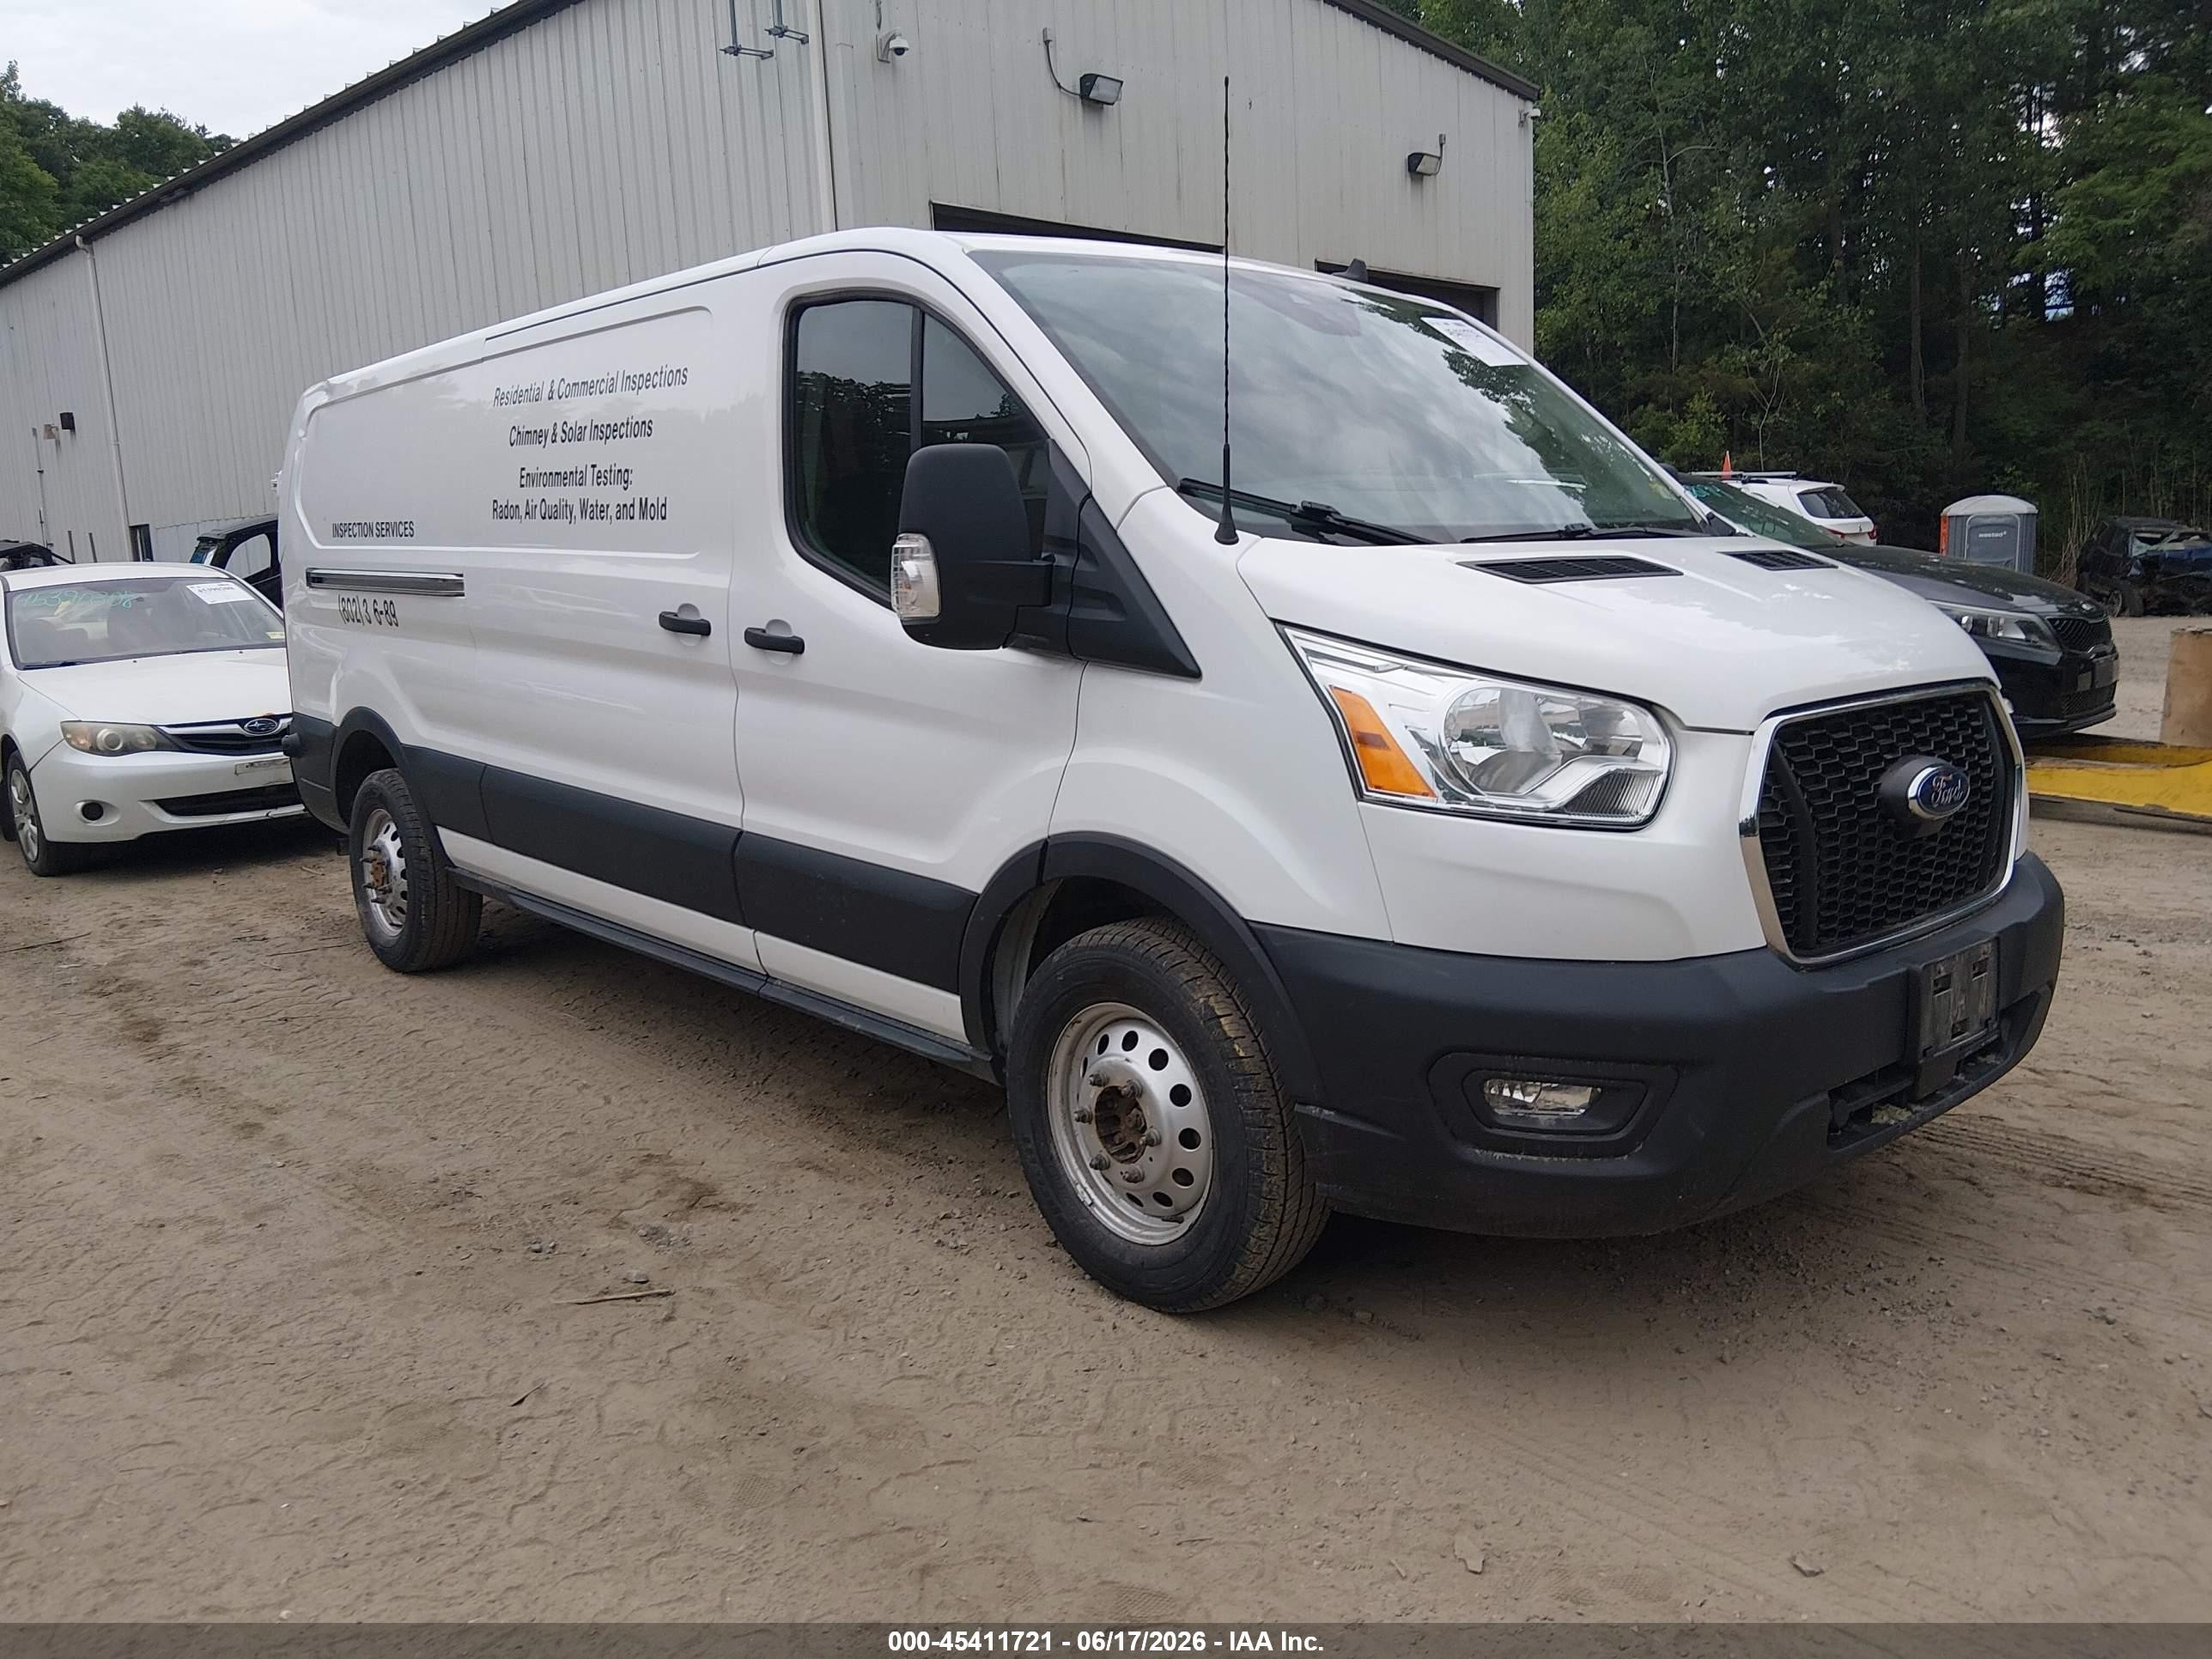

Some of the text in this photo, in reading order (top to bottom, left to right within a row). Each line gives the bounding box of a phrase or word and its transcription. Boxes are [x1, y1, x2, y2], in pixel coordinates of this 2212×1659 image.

[493, 364, 688, 407] Residential & Commercial Inspections
[509, 416, 653, 448] Chimney & Solar Inspections
[520, 463, 633, 491] Environmental Testing:
[492, 496, 667, 525] Radon, Air Quality, Water, and Mold
[332, 520, 415, 538] INSPECTION SERVICES
[1931, 774, 1964, 807] Ford
